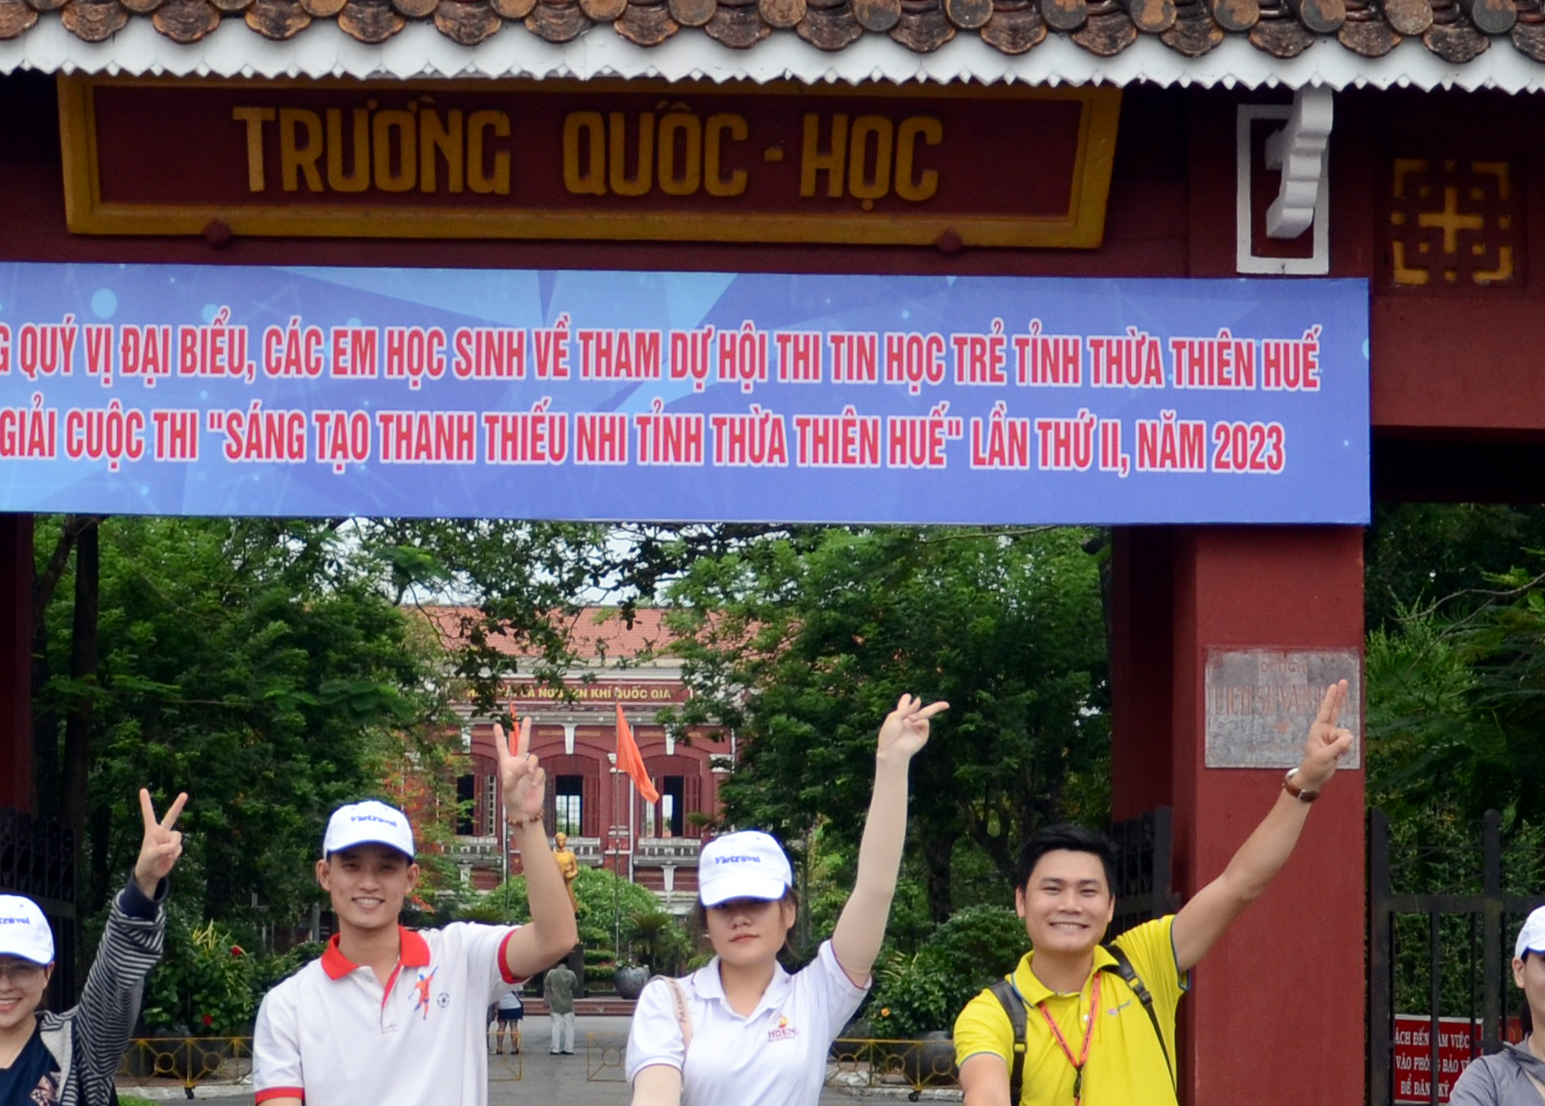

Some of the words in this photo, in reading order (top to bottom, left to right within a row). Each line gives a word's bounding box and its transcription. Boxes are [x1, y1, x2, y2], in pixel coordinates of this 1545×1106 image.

[561, 97, 746, 197] QUỐC
[800, 115, 941, 210] HỌC
[21, 315, 76, 378] QUÝ
[86, 326, 112, 385] VỊ
[122, 326, 169, 385] ĐẠI
[180, 307, 254, 382] BIỂU,
[265, 317, 322, 374] CÁC
[332, 328, 376, 375] EM
[387, 328, 444, 388] HỌC
[455, 329, 524, 377] SINH
[534, 314, 569, 377] VỀ
[579, 330, 660, 378] THAM
[671, 326, 713, 391] DỰ
[719, 322, 765, 392] HỘI
[777, 332, 820, 380] THI
[830, 333, 876, 382] TIN
[886, 334, 942, 393] HỌC
[953, 319, 1004, 383] TRẺ
[1015, 319, 1079, 385] TỈNH
[1089, 327, 1162, 386] THỪA
[1171, 330, 1254, 387] THIÊN
[1263, 325, 1320, 389] HUẾ
[0, 393, 55, 457] GIẢI
[66, 400, 143, 470] CUỘC
[154, 412, 196, 459] THI
[209, 402, 304, 459] "SÁNG
[315, 412, 368, 471] TẠO
[380, 413, 474, 462] THANH
[485, 398, 566, 462] THIẾU
[576, 415, 626, 462] NHI
[636, 399, 702, 463] TỈNH
[713, 407, 786, 464] THỪA
[796, 408, 879, 466] THIÊN
[888, 402, 961, 466] HUẾ"
[972, 402, 1027, 467] LẦN
[1038, 410, 1093, 469] THỨ
[1101, 421, 1128, 476] II,
[1137, 411, 1205, 470] NĂM
[1214, 423, 1284, 472] 2023
[592, 685, 612, 699] KHÍ
